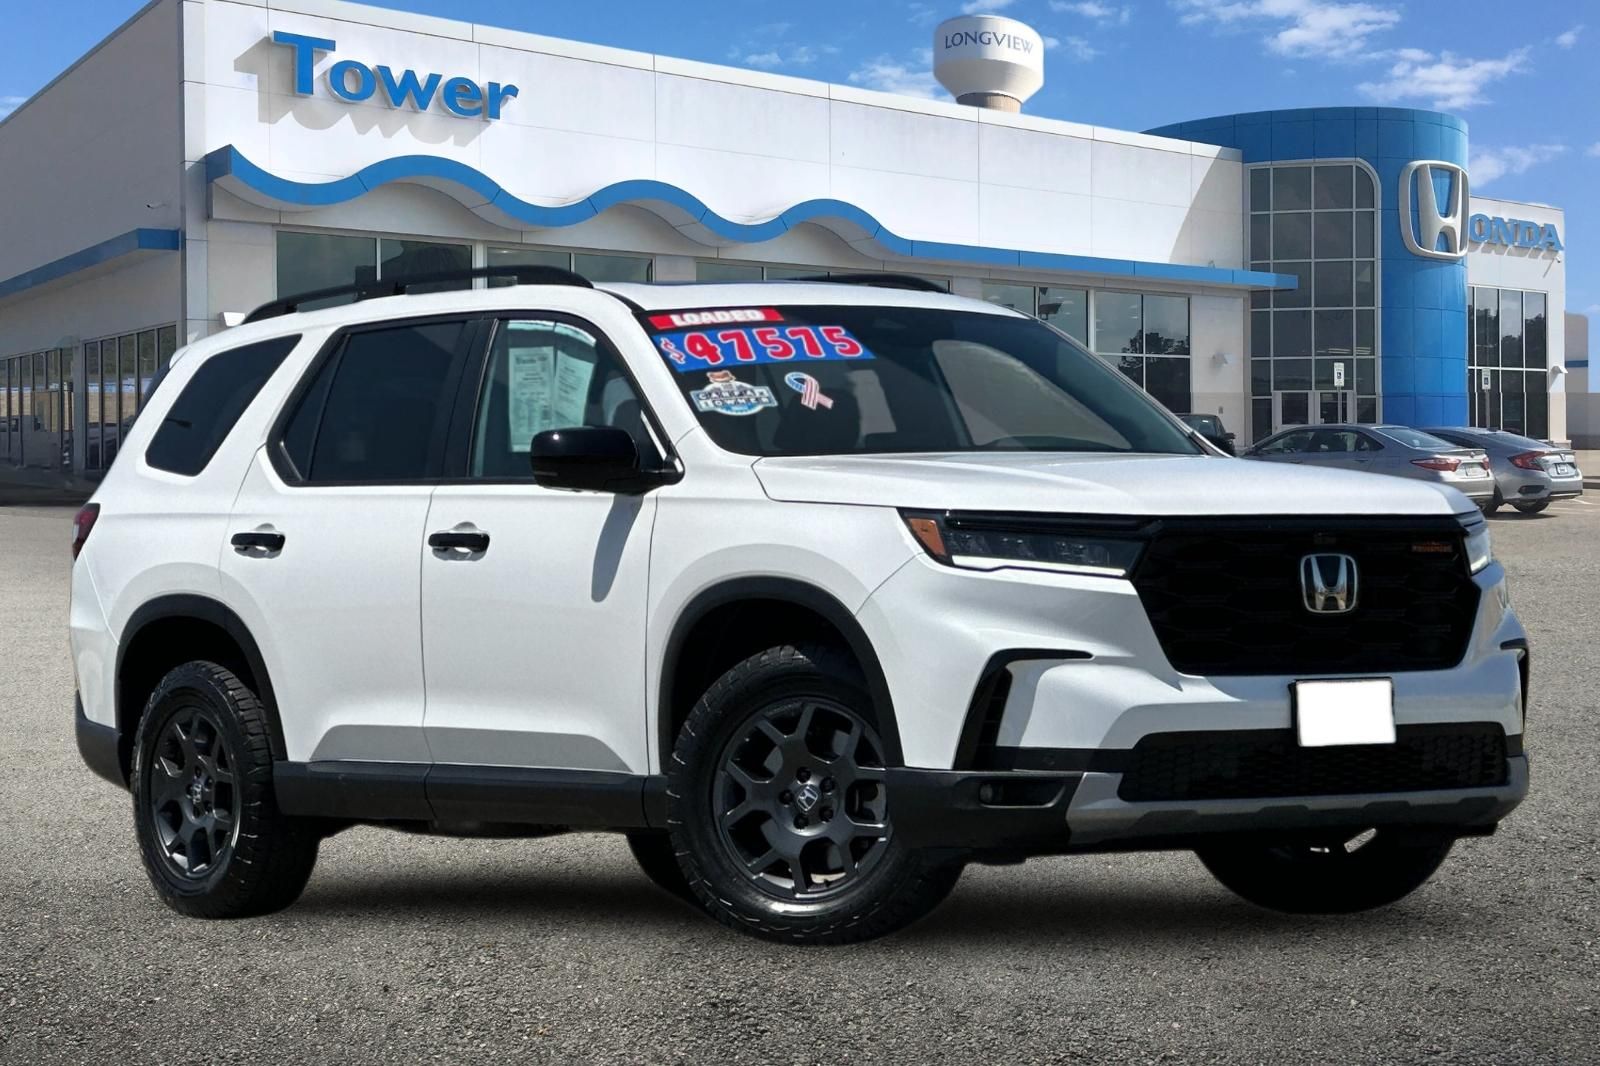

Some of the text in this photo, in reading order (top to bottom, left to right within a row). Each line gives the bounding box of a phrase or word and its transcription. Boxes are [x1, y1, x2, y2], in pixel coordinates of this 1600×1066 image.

[945, 31, 1034, 54] LONGVIEW
[272, 30, 520, 120] Tower
[1469, 213, 1565, 252] ONDA
[670, 309, 766, 326] LOADED
